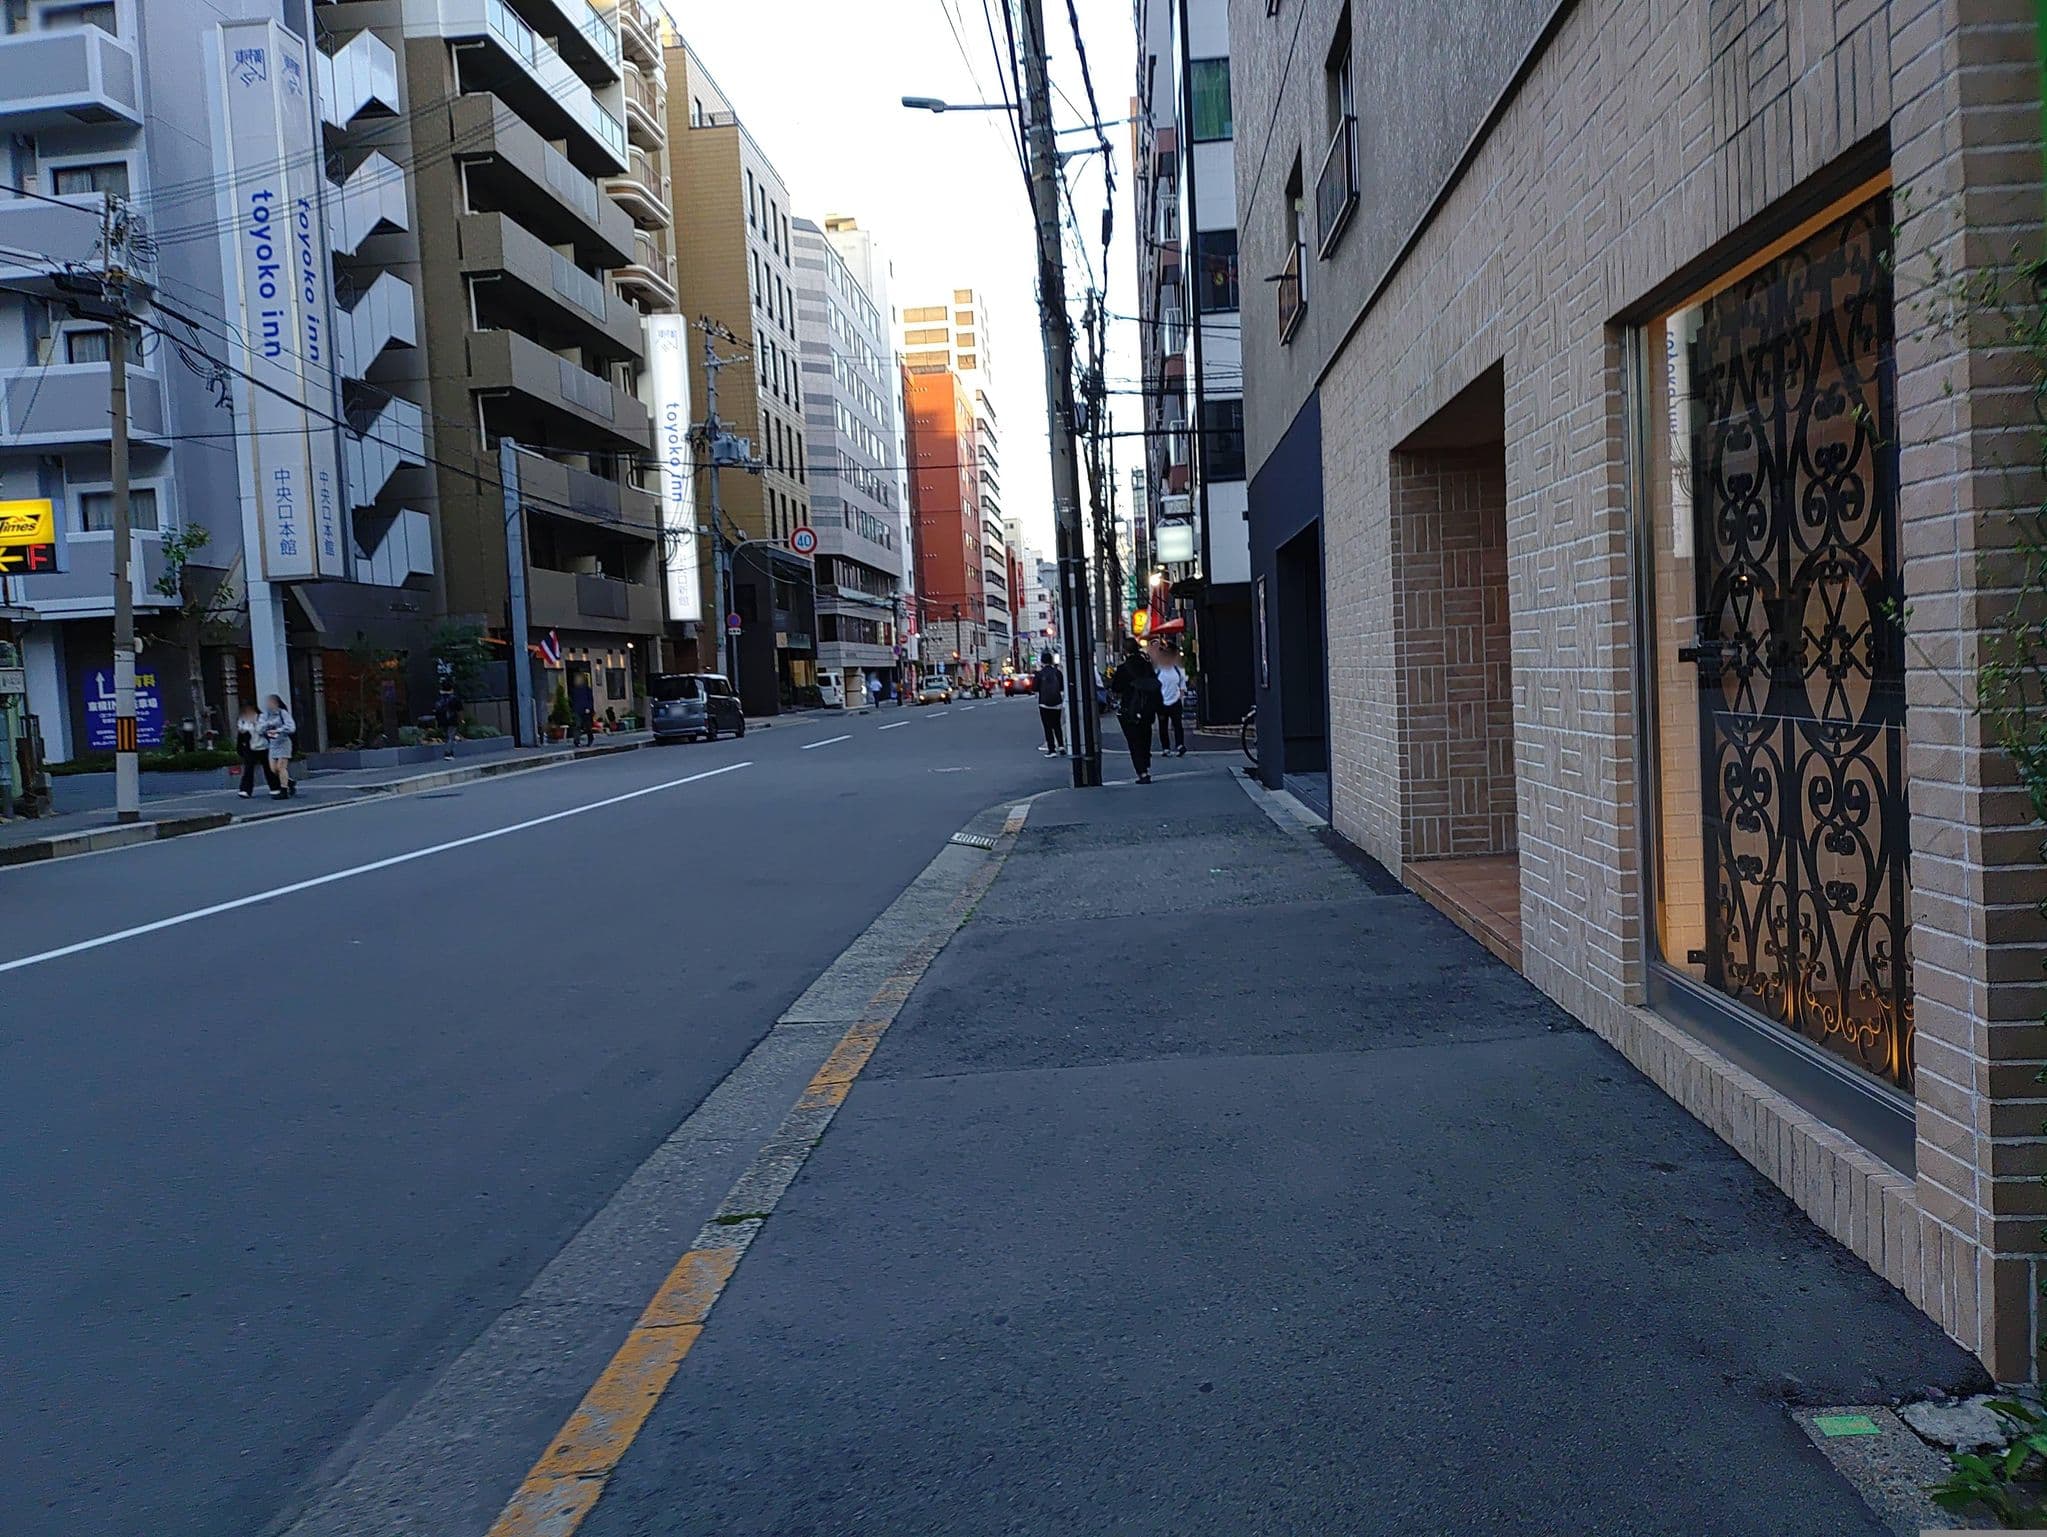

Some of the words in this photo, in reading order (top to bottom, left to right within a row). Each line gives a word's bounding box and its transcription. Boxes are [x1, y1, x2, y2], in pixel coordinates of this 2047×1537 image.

[249, 189, 280, 299] toyoko
[298, 198, 316, 304] toyoko
[262, 310, 284, 357] inn
[306, 314, 320, 361] inn
[664, 401, 683, 469] toyoko
[274, 466, 297, 555] 中央口本館
[29, 544, 47, 570] F
[797, 534, 811, 548] 40
